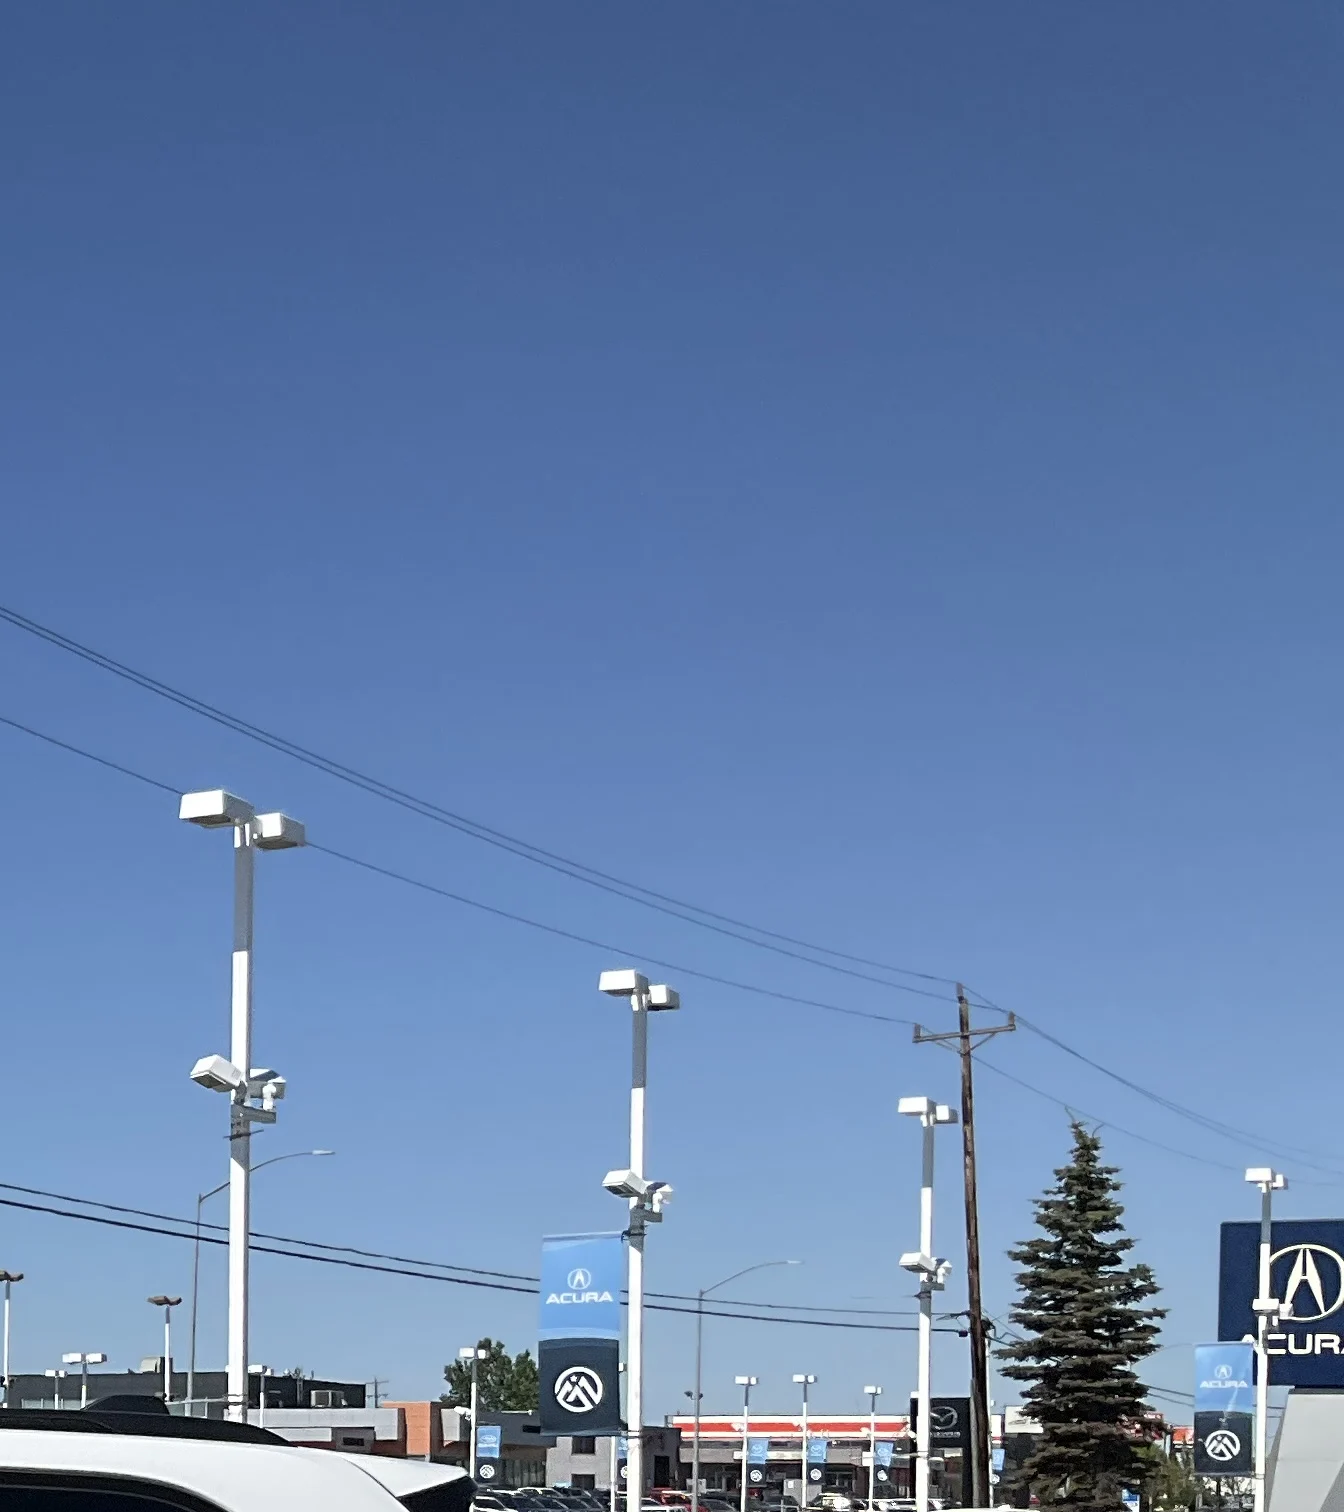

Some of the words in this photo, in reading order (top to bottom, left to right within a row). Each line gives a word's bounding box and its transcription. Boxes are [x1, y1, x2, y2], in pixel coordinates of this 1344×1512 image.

[545, 1291, 614, 1305] ACURA
[1239, 1333, 1344, 1355] CUR
[1199, 1380, 1249, 1389] ACURA
